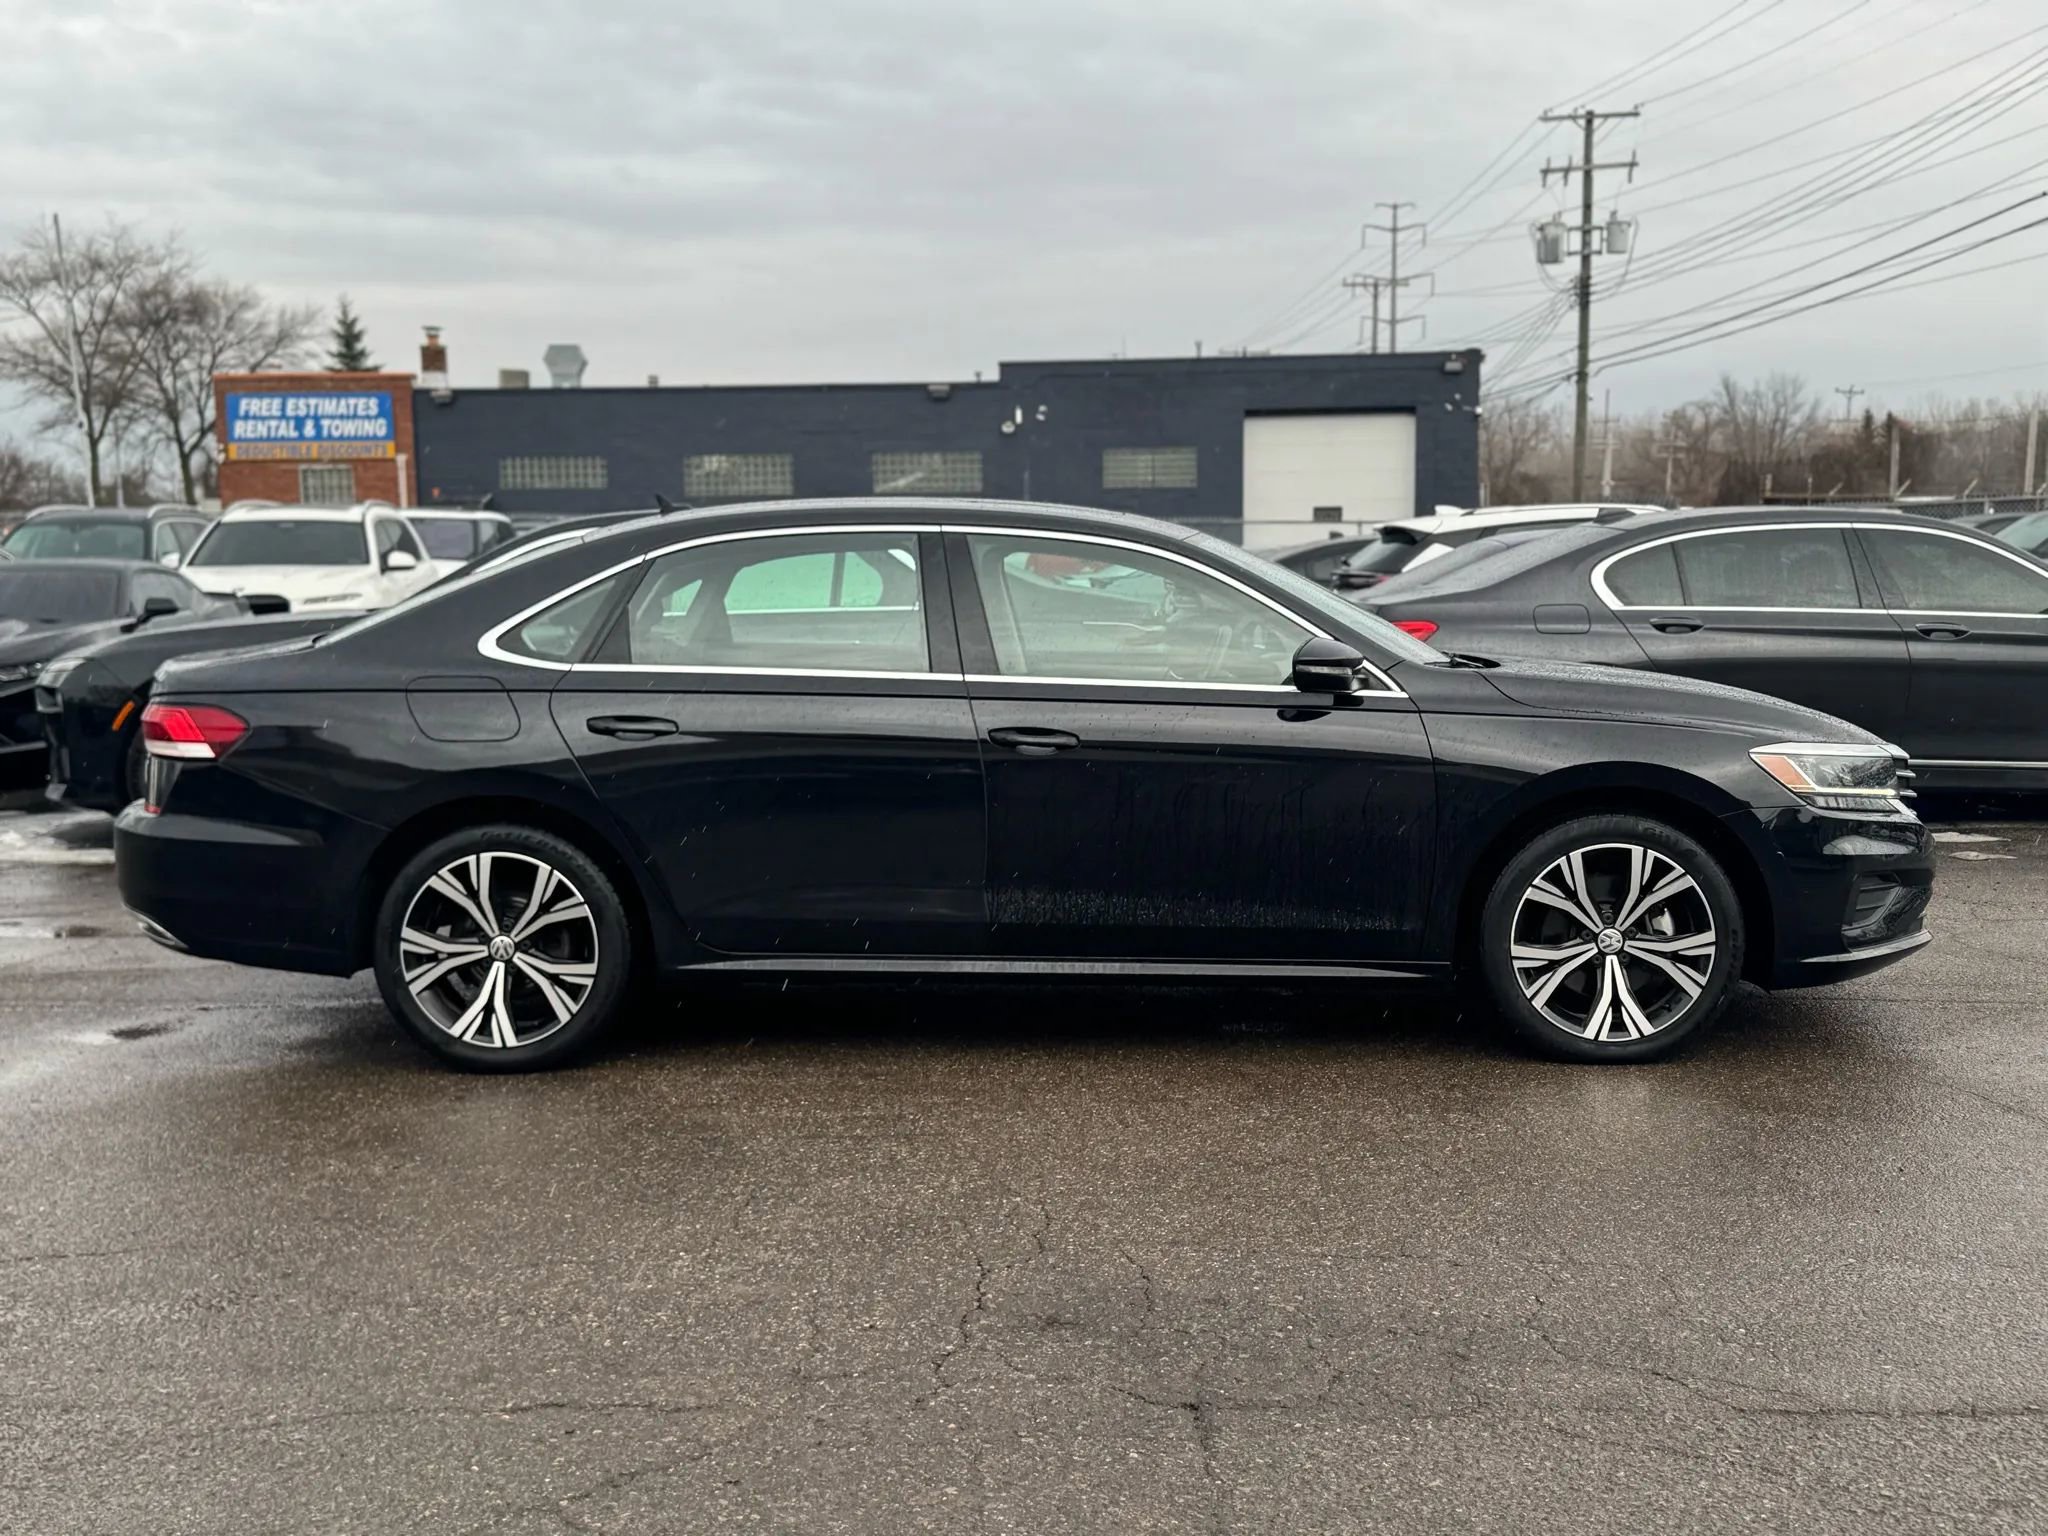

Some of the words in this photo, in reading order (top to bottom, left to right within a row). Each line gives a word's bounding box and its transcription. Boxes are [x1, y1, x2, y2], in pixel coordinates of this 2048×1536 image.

[239, 397, 282, 417] FREE
[286, 396, 379, 417] ESTIMATES
[234, 419, 299, 439] RENTAL
[303, 420, 315, 438] &
[320, 418, 387, 438] TOWING
[236, 444, 312, 459] DEDUCTIBLE
[318, 443, 387, 458] DISCOUNTS
